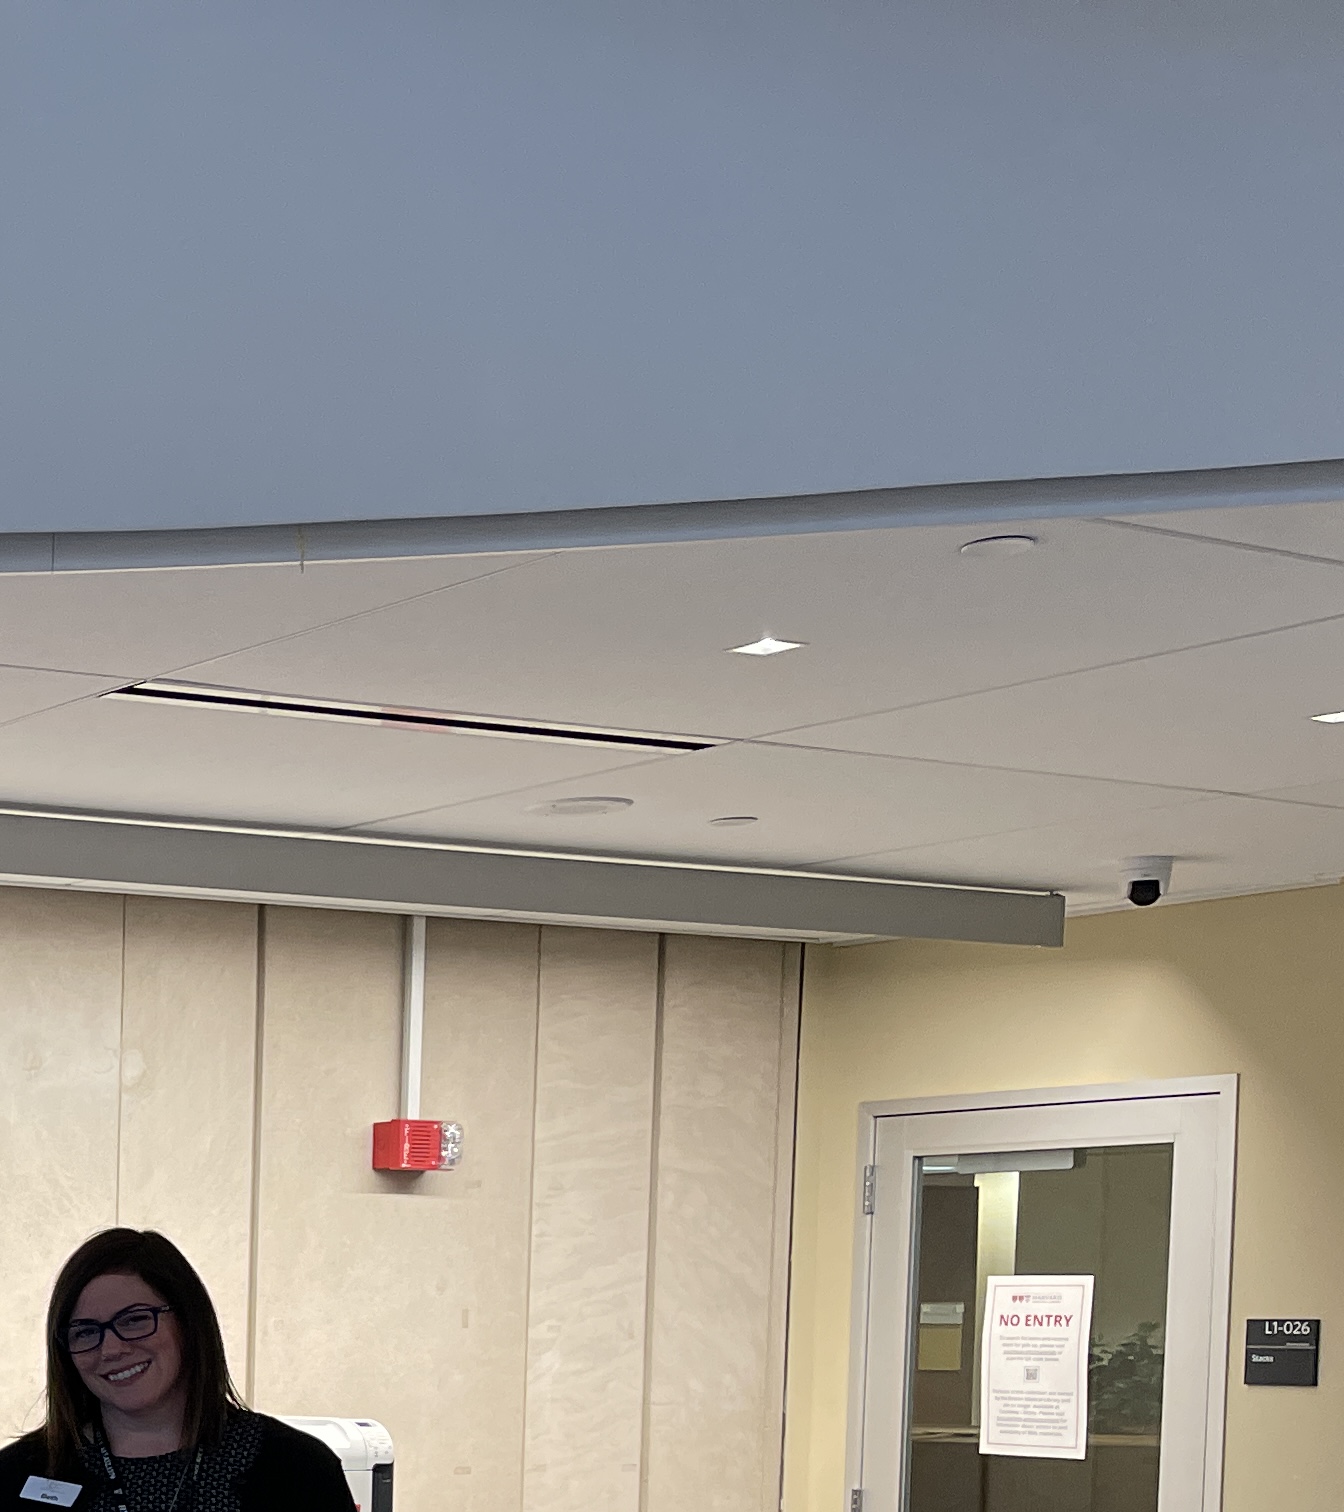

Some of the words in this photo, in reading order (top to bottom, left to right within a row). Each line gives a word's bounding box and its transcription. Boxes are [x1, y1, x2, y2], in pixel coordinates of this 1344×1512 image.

[999, 1314, 1021, 1327] NO
[1024, 1314, 1074, 1327] ENTRY
[1265, 1321, 1311, 1335] L1-026
